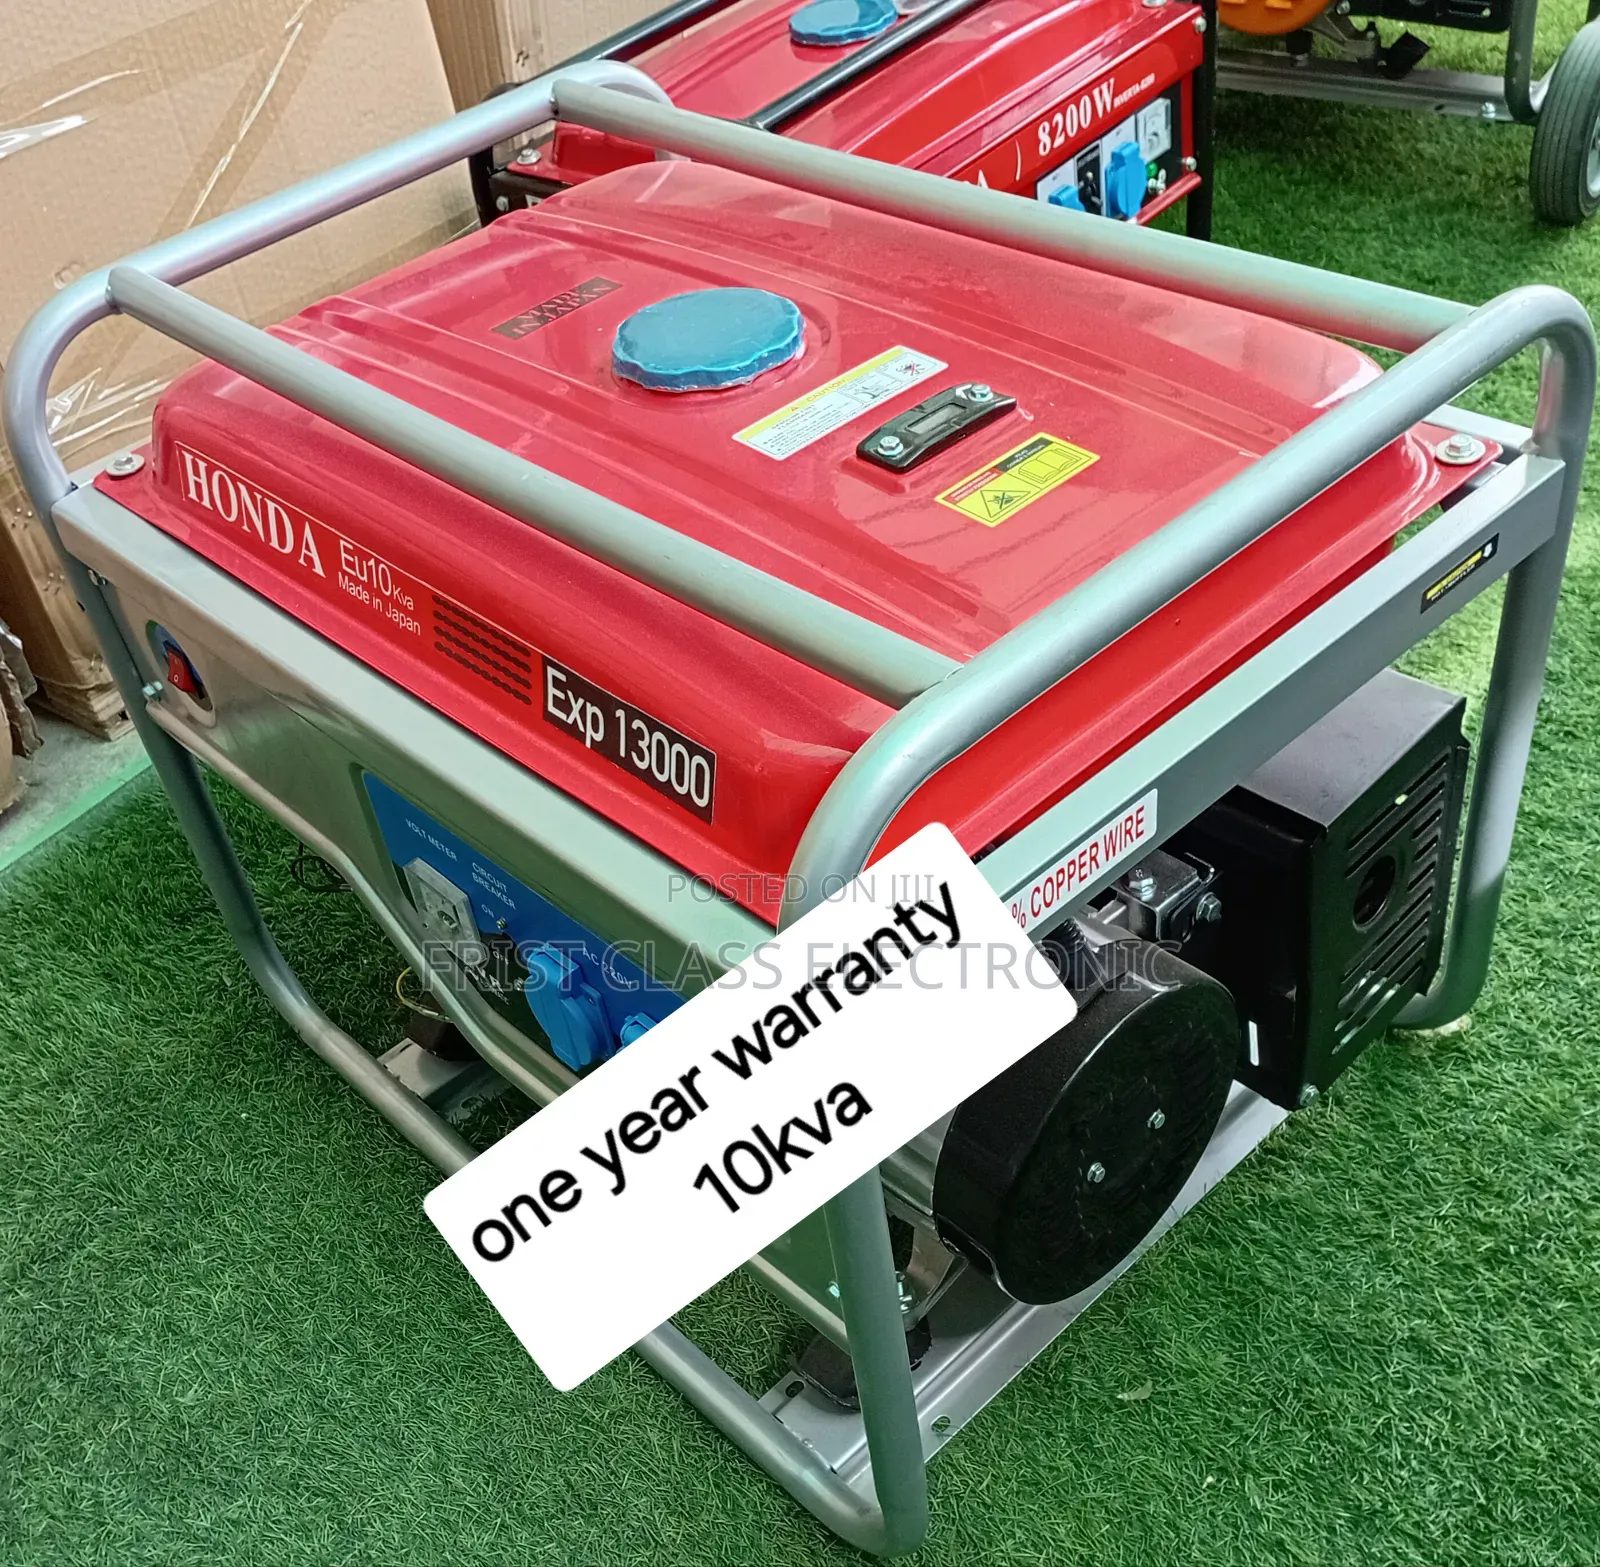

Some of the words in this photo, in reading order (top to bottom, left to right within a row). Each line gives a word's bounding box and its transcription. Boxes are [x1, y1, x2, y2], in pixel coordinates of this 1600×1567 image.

[1037, 77, 1116, 157] 8200W
[543, 285, 613, 322] JAPAN
[806, 378, 845, 403] CAUTION
[182, 450, 326, 578] HONDA
[338, 571, 370, 605] Made
[372, 593, 383, 613] in
[385, 603, 422, 636] Japan
[546, 665, 605, 749] Exp
[615, 708, 711, 808] 13000
[405, 818, 426, 839] VOLT
[427, 834, 458, 862] METER
[1030, 841, 1100, 918] COPPER
[1103, 805, 1145, 862] WIRE
[471, 861, 508, 893] CIRCUIT
[471, 871, 516, 910] BREAKER
[481, 903, 495, 918] ON
[582, 947, 600, 966] AC
[602, 961, 632, 990] 220V
